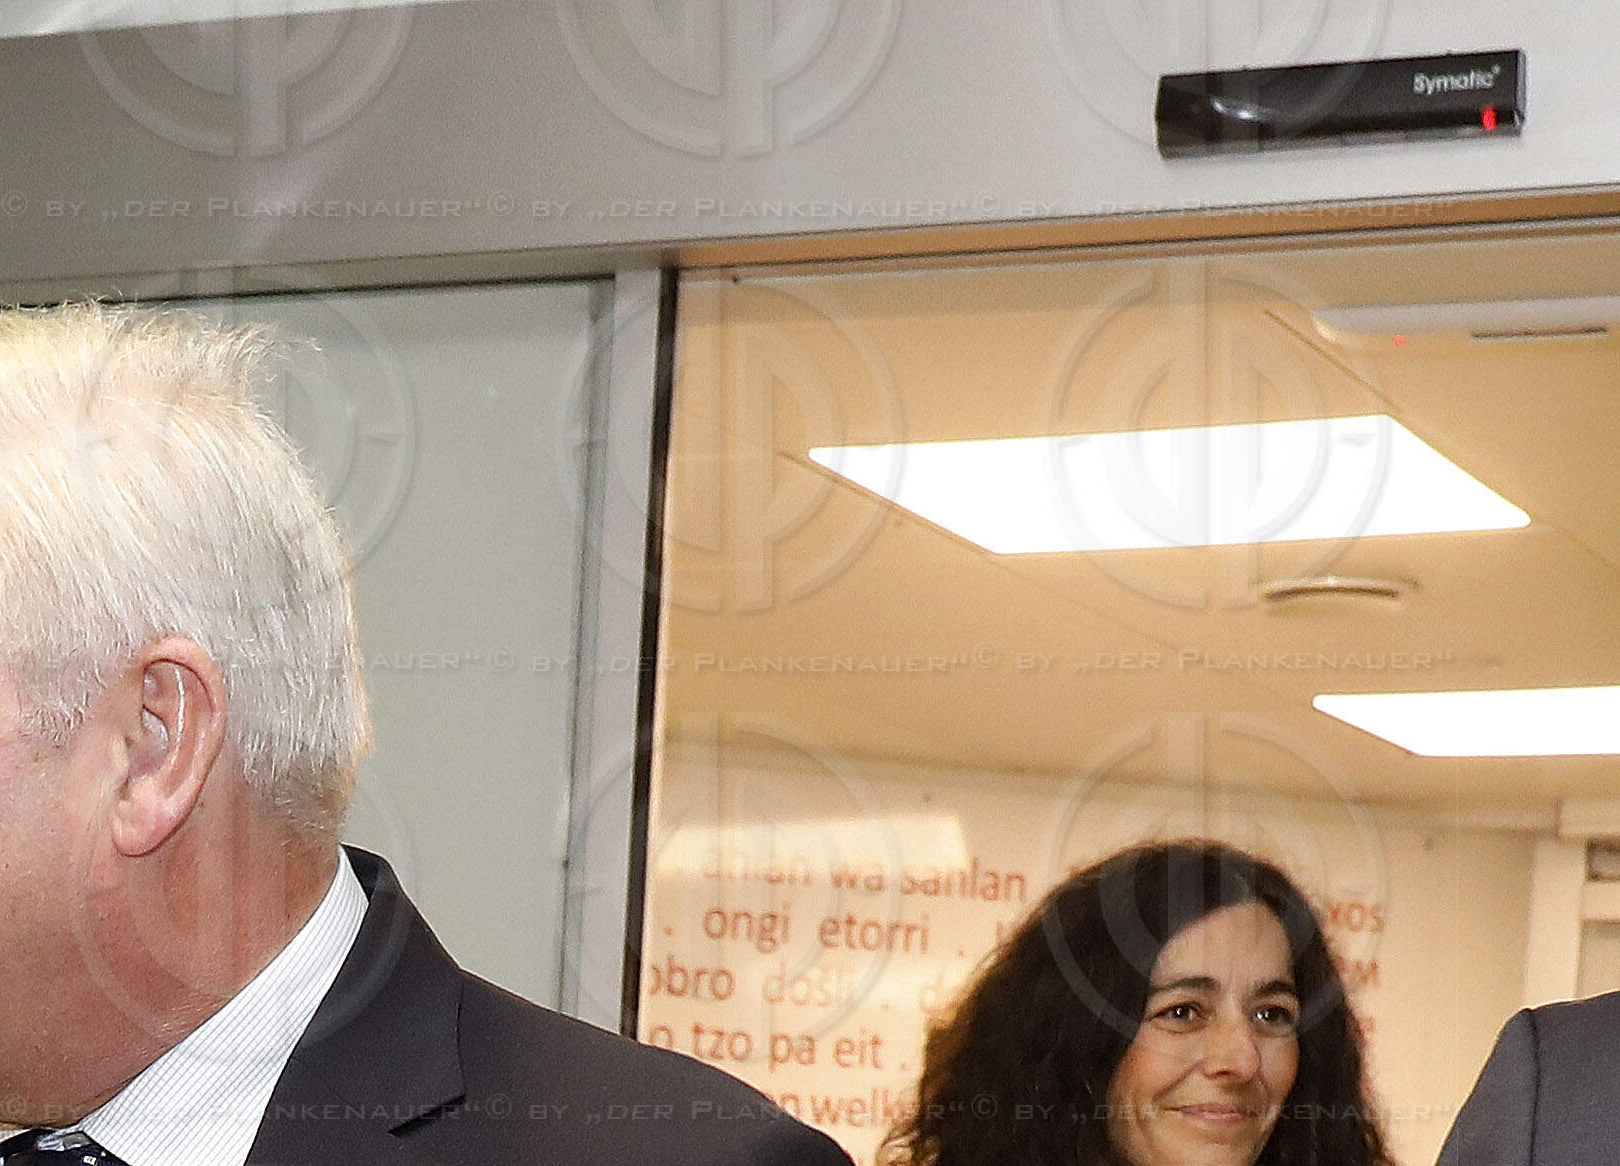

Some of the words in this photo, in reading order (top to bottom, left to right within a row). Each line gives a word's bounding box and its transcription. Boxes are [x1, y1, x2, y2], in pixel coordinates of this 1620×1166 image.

[702, 902, 792, 954] ongi
[818, 911, 931, 954] etorri
[771, 1033, 817, 1073] pa
